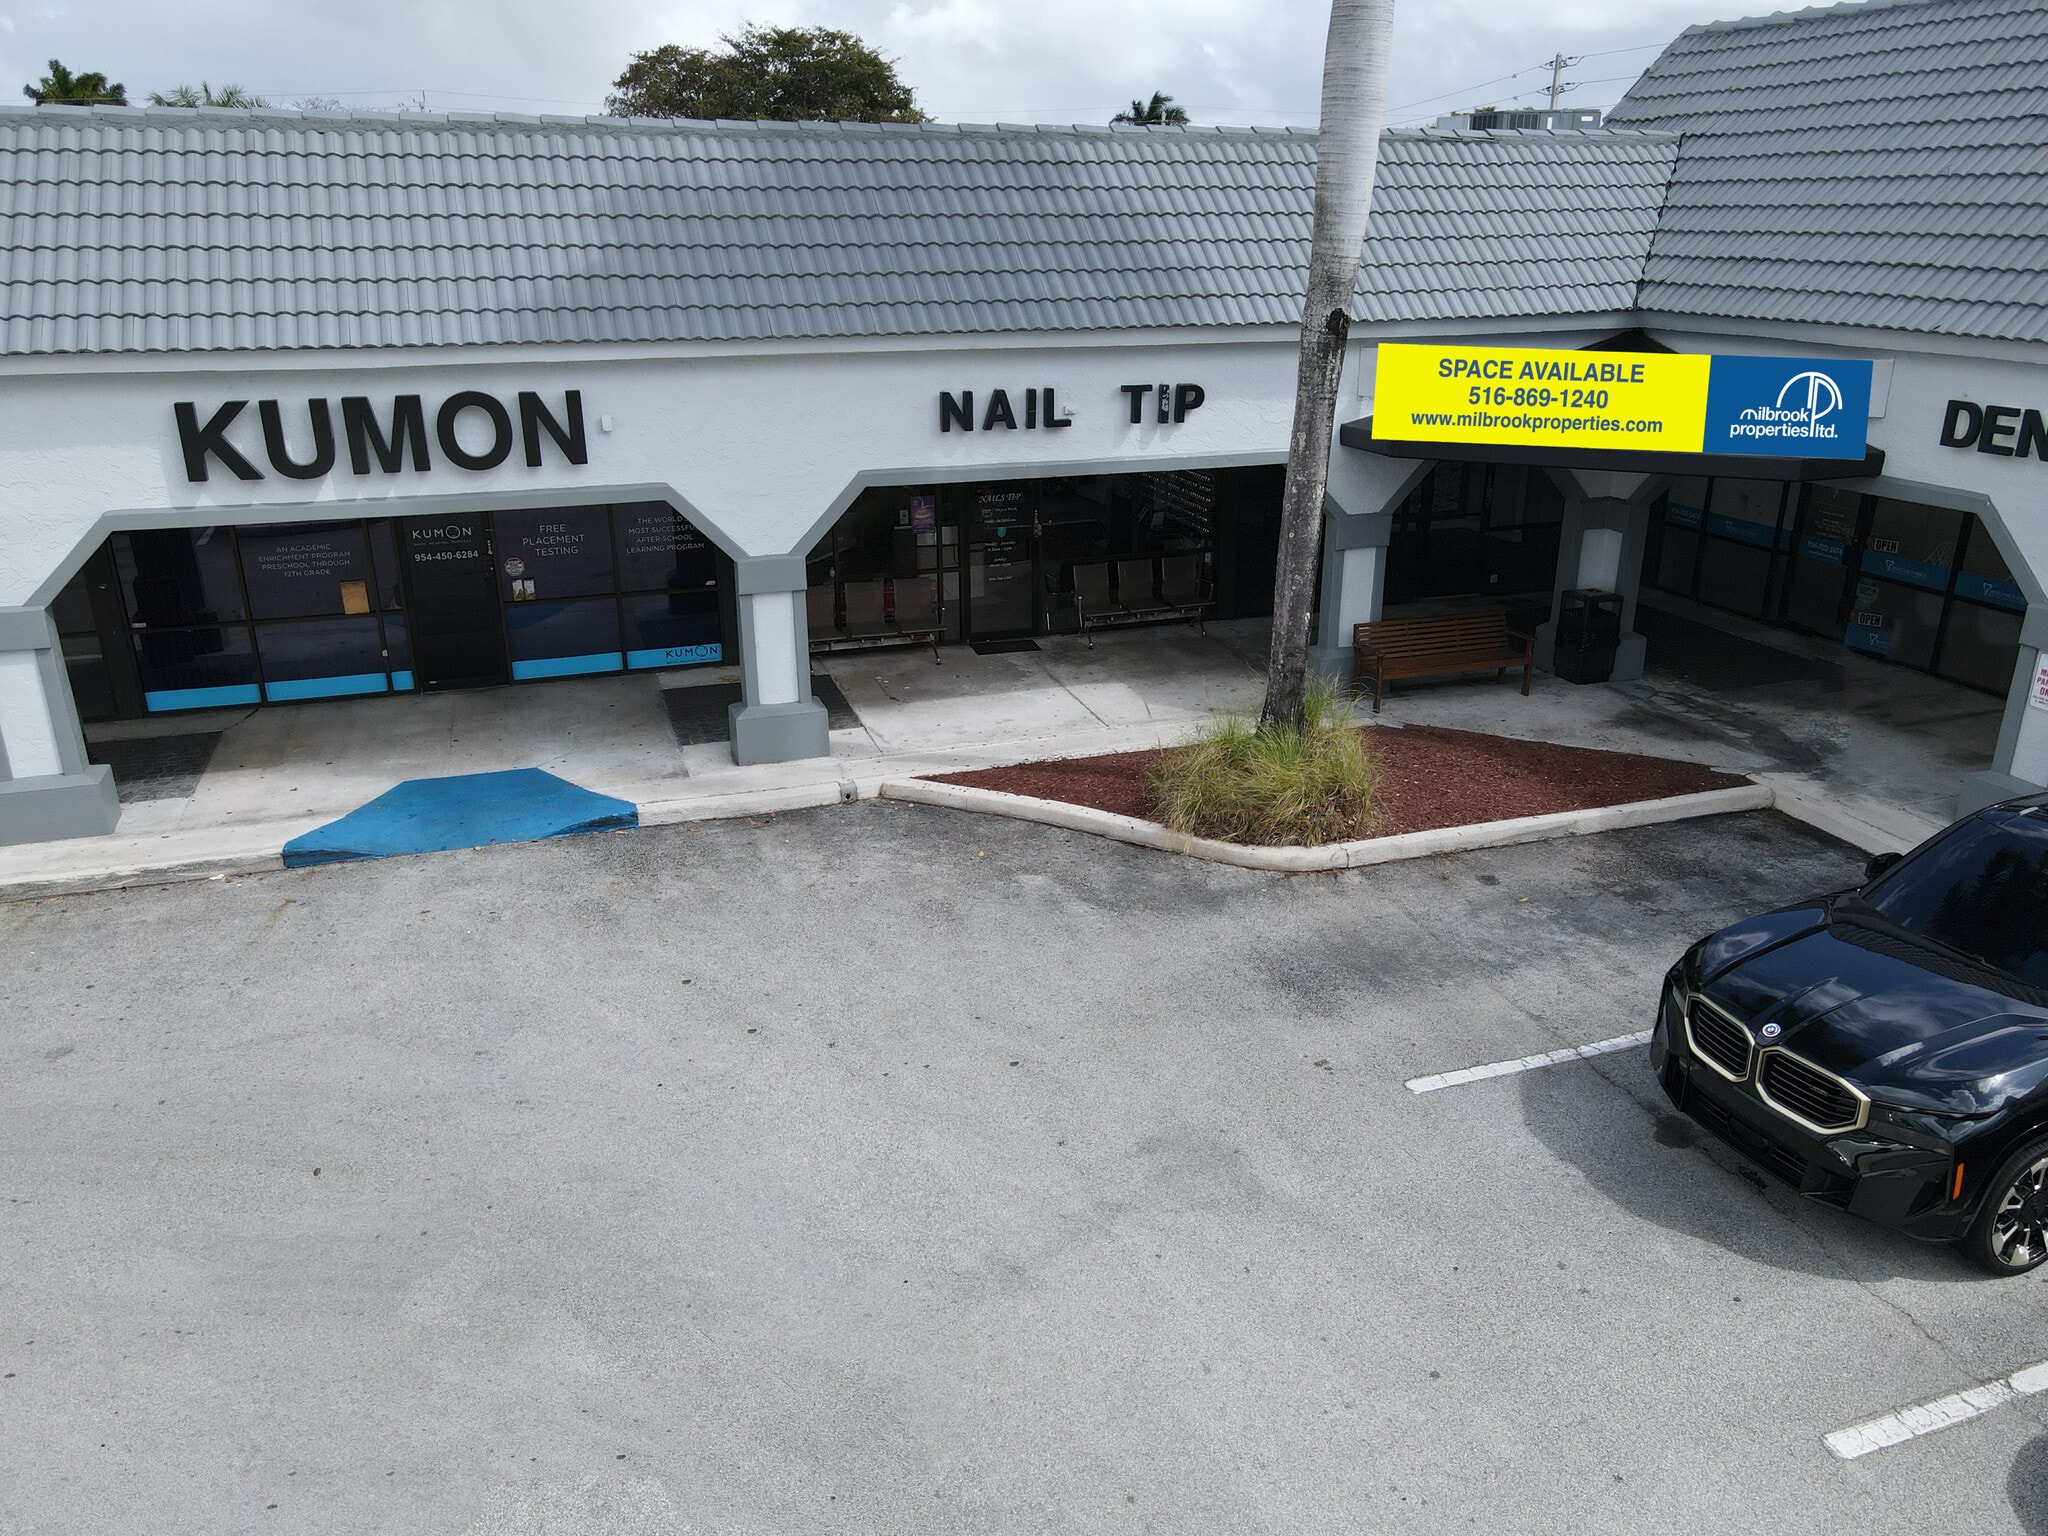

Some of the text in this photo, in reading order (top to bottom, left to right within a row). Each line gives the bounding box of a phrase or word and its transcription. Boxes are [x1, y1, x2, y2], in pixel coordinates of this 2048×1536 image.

[1438, 358, 1645, 384] SPACE AVAILABLE
[1468, 386, 1609, 410] 516-869-1240
[939, 382, 1206, 433] NAIL TIP
[1739, 406, 1810, 422] milbrook
[1411, 410, 1663, 434] www.milbrookproperties.com
[174, 389, 589, 483] KUMON
[1729, 422, 1838, 439] properties ltd.
[978, 493, 1005, 503] NAILS
[412, 525, 472, 539] KUMON
[539, 523, 566, 533] FREE
[651, 524, 696, 533] SUCCESSFU
[522, 534, 585, 546] PLACEMENT
[636, 534, 694, 543] AFTER-SCHOOL
[290, 543, 331, 552] ACADEMIC
[535, 545, 579, 556] TESTING
[626, 542, 705, 554] LEARNING PROGRAM
[1875, 540, 1898, 552] OPEN
[258, 551, 351, 562] ENRICHMENT PROGRAM
[414, 550, 479, 562] 954-450-6284
[262, 559, 350, 570] PRESCHOOL THROUGH
[1859, 613, 1881, 626] OPEN
[665, 645, 718, 658] KUMON
